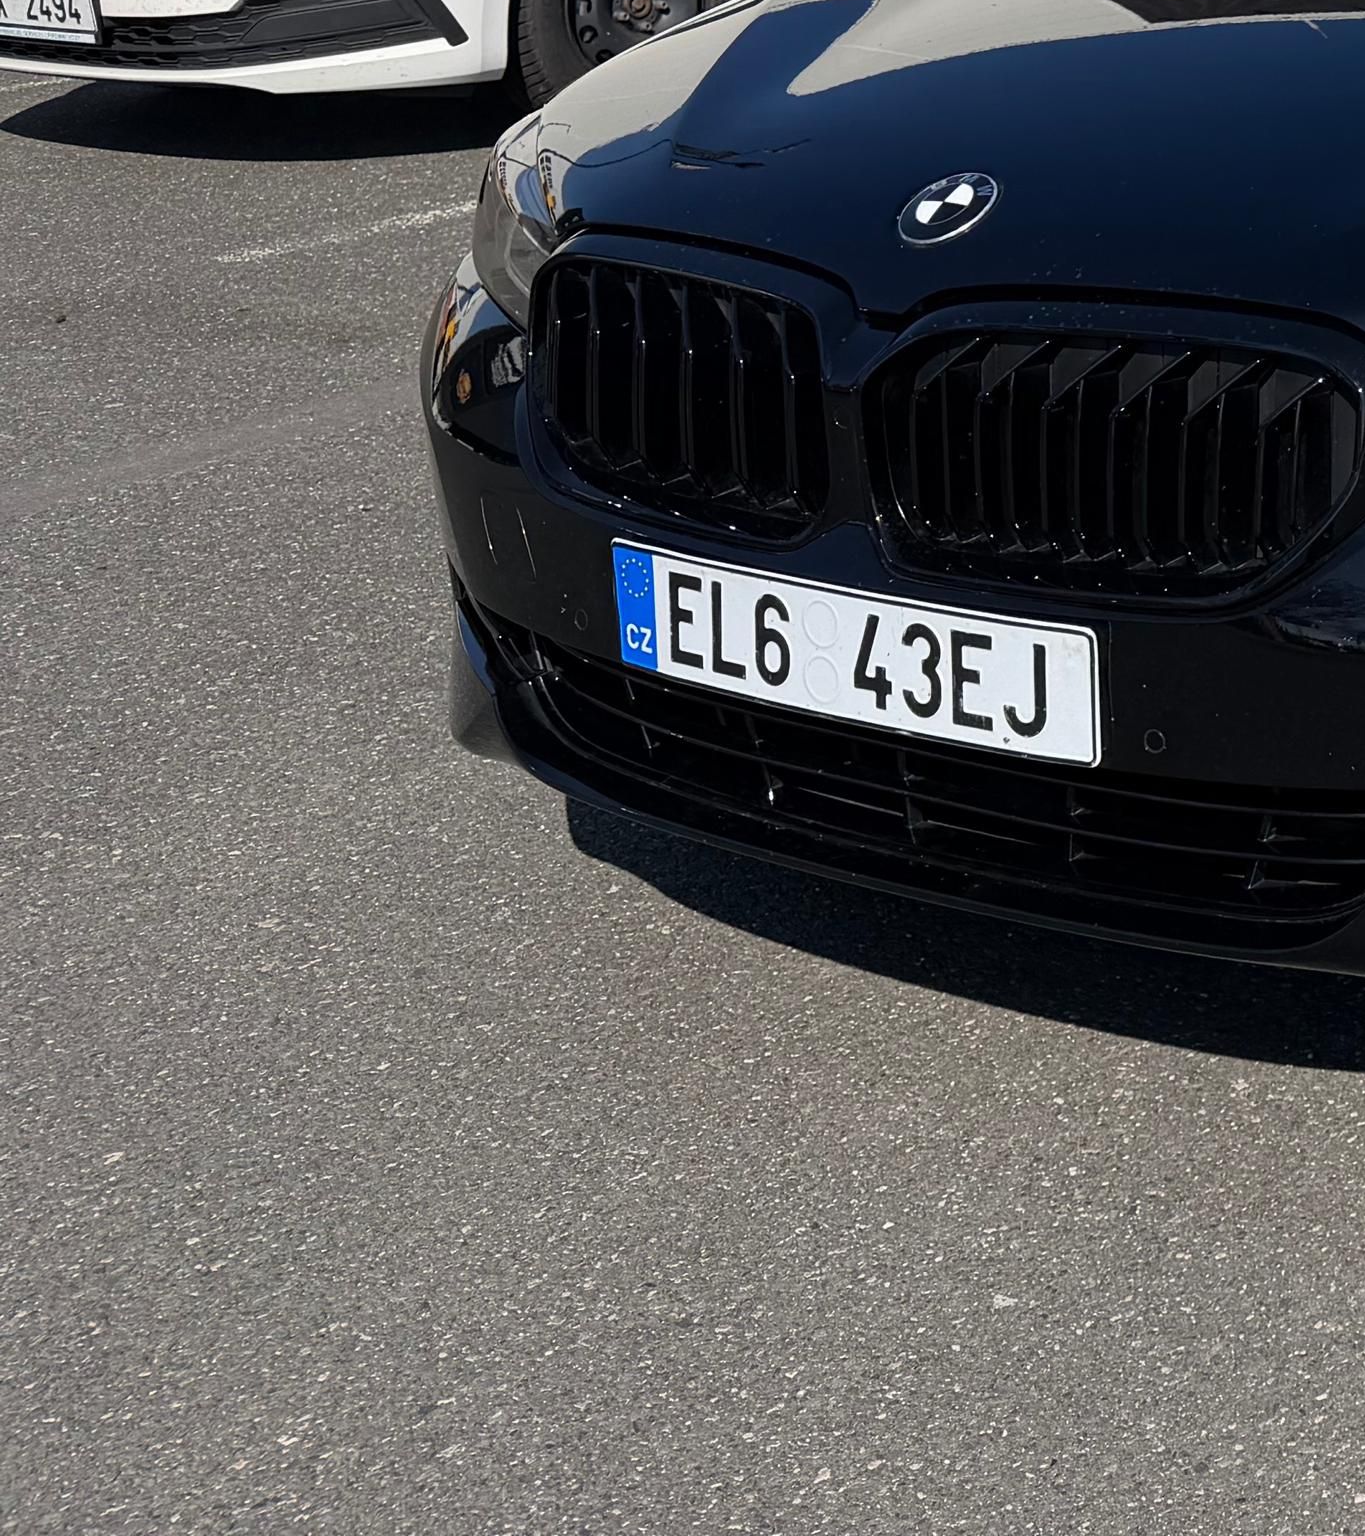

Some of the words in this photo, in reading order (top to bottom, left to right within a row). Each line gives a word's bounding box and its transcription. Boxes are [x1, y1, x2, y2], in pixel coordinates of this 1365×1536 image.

[625, 623, 653, 654] CZ
[667, 570, 791, 687] EL6
[853, 613, 1048, 738] 43EJ
